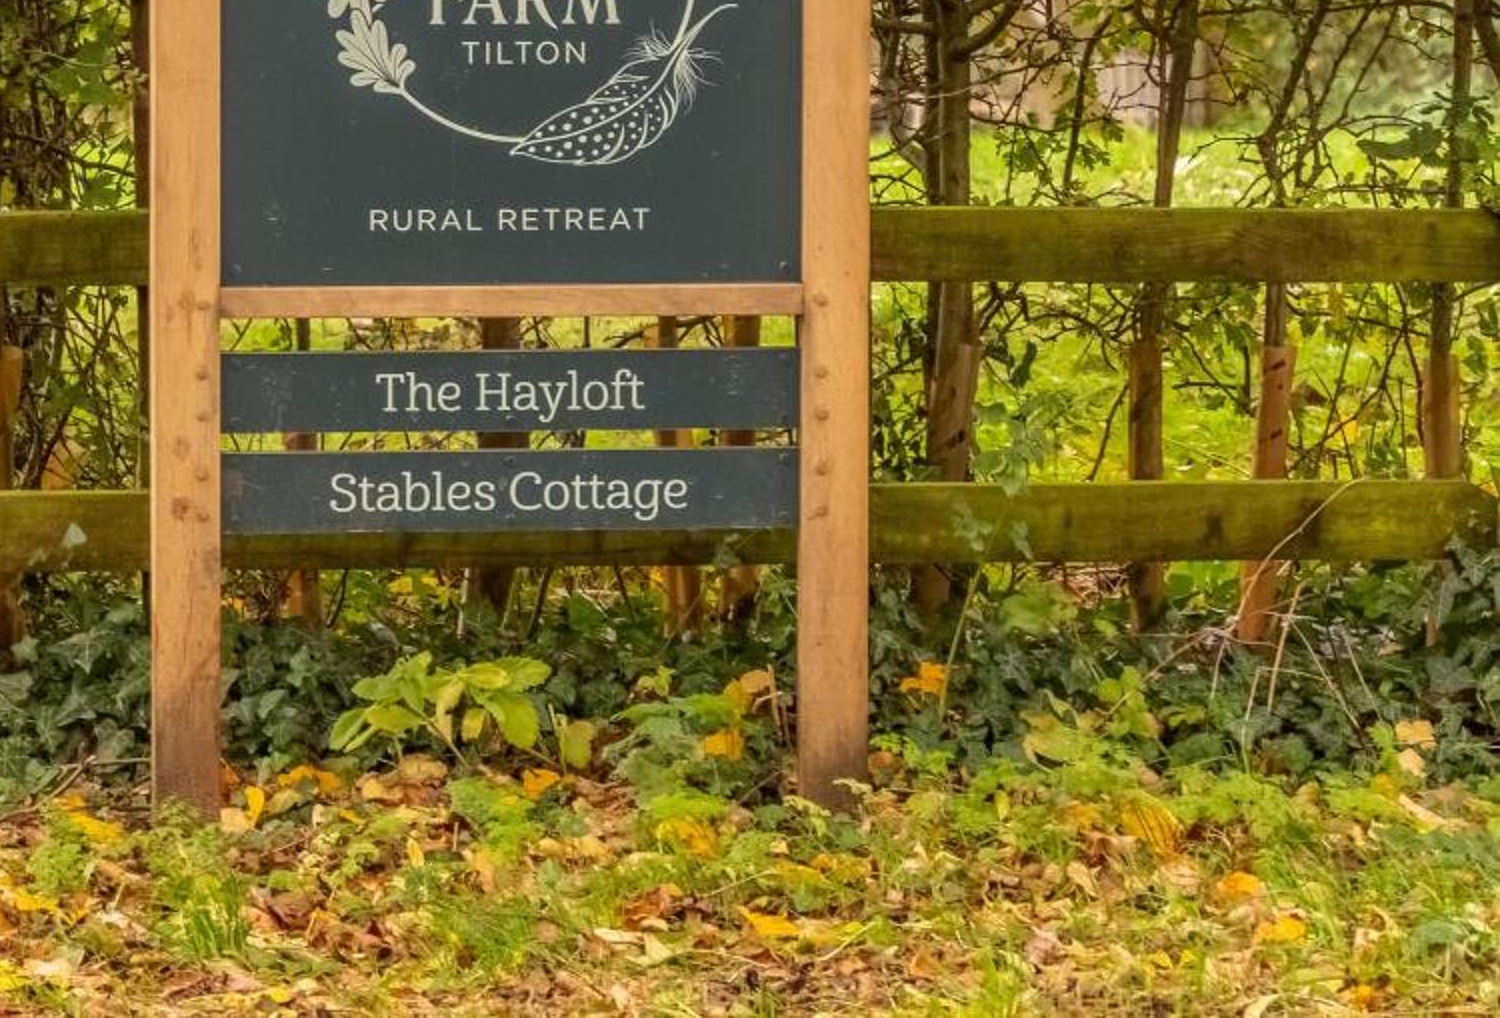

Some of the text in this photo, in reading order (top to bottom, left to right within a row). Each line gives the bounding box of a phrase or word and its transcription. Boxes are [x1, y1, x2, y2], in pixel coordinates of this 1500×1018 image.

[461, 40, 586, 65] TILTON
[369, 207, 650, 232] RURAL RETREAT
[375, 368, 645, 423] The Hayloft
[329, 470, 688, 521] Stables Cottage
